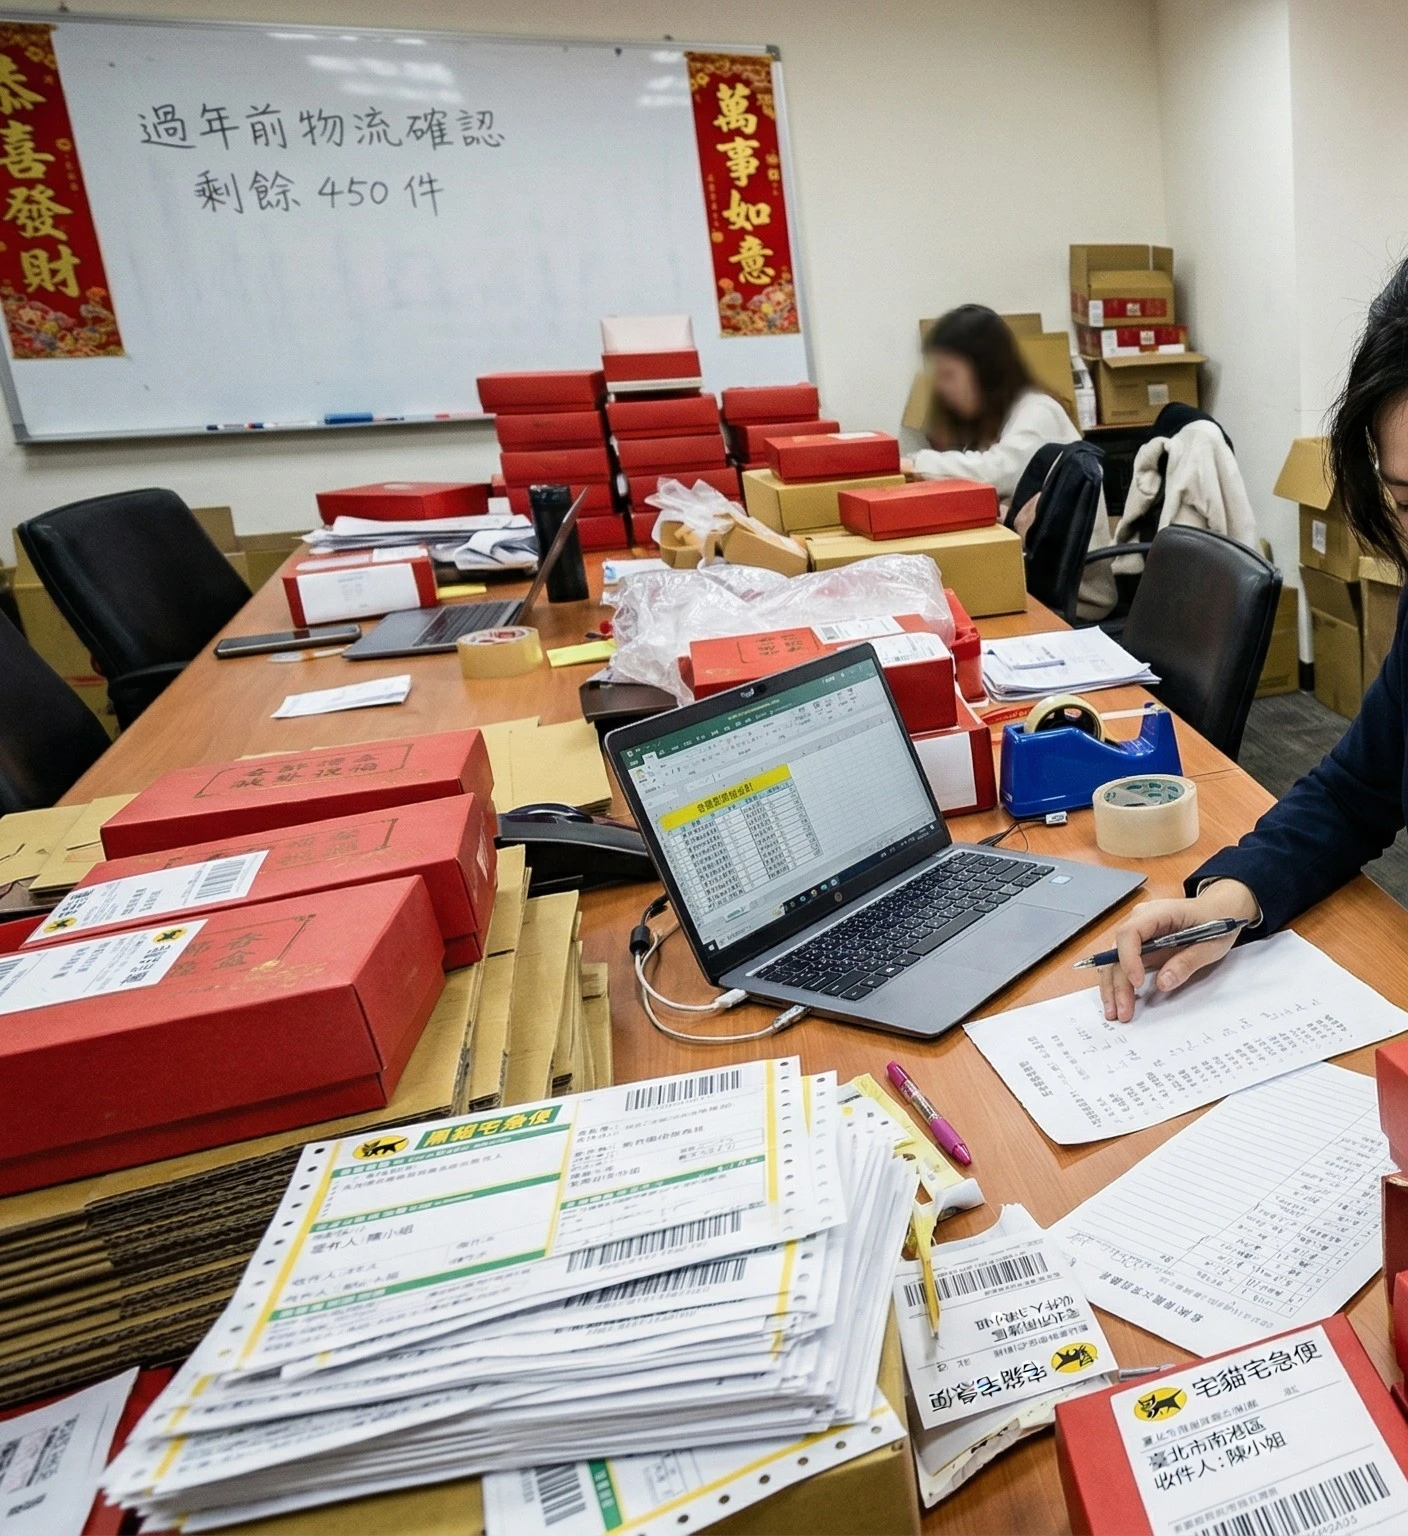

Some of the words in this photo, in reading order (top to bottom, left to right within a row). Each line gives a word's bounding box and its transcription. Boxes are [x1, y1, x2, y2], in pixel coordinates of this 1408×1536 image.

[138, 102, 505, 150] 過年前物流確認
[194, 170, 301, 214] 剩餘
[318, 176, 389, 208] 450
[404, 172, 444, 216] 件
[713, 82, 776, 285] 萬事如意
[1192, 1339, 1323, 1399] 宅貓宅急便
[1147, 1416, 1267, 1472] 北市南港區
